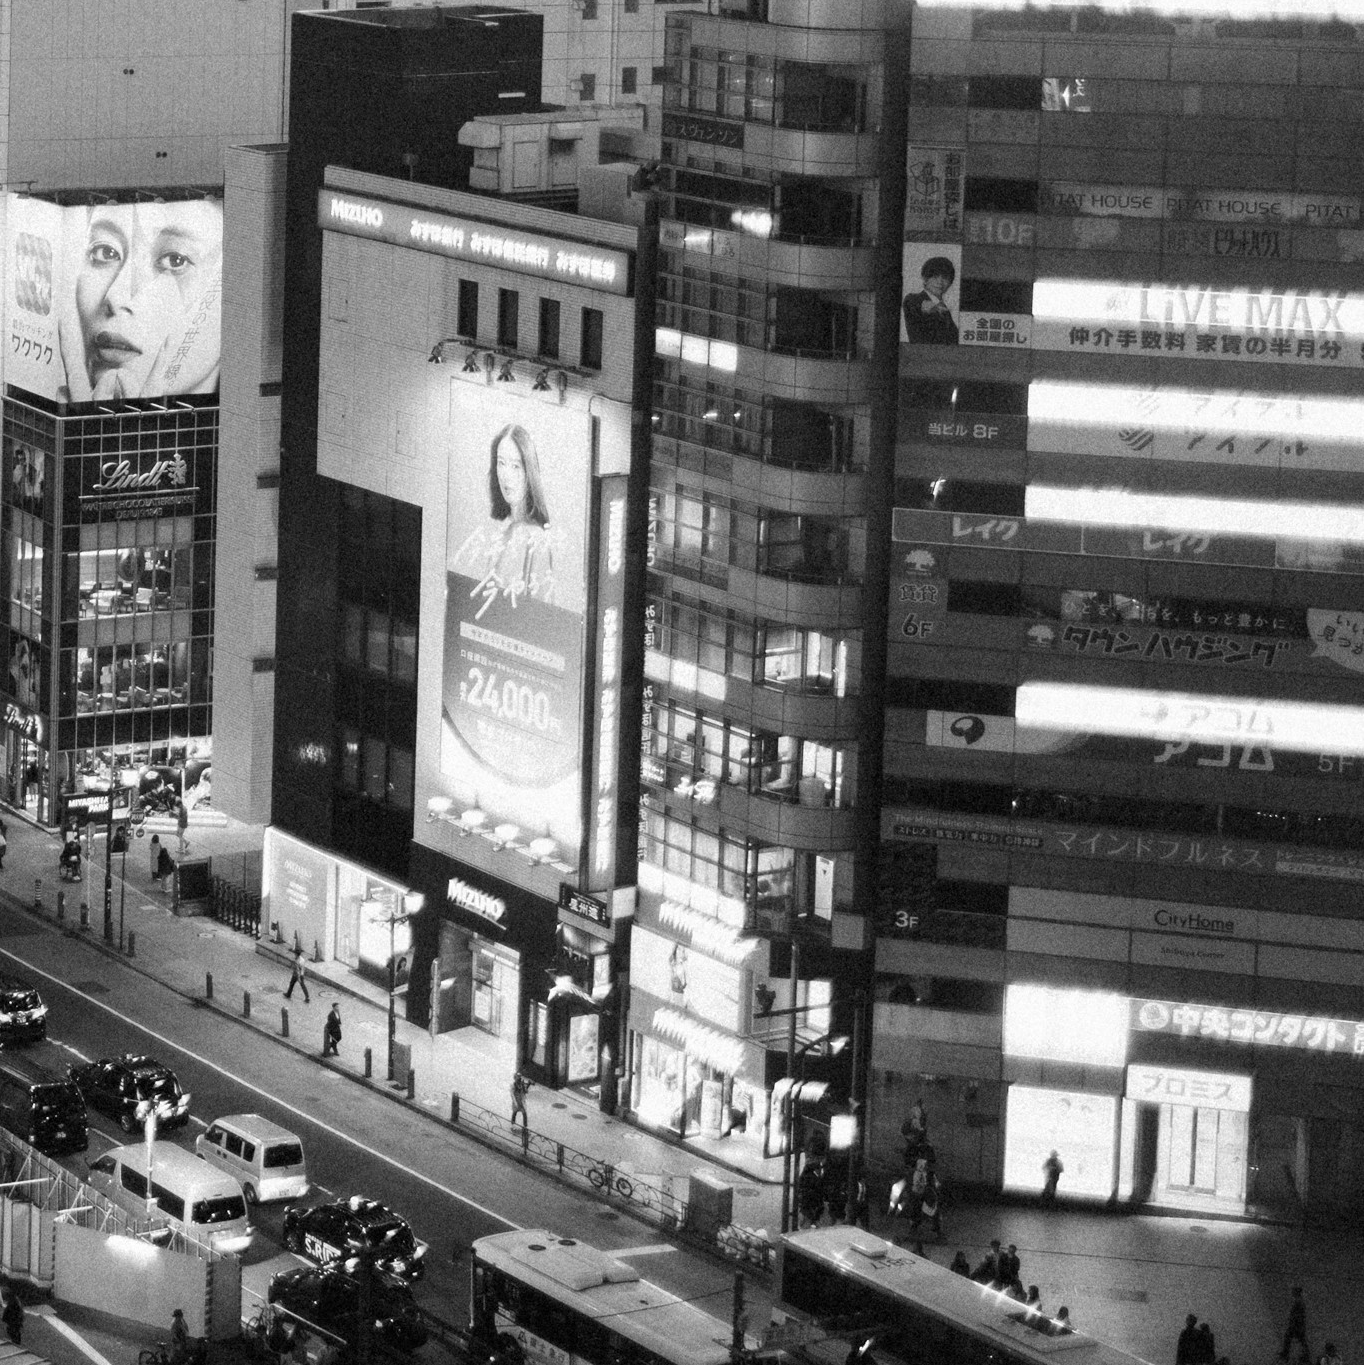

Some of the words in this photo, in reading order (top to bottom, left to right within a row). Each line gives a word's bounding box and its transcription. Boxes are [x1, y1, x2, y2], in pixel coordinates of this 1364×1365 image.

[331, 198, 383, 227] MIZUHO
[1091, 194, 1153, 210] HOUSE
[1218, 200, 1281, 215] HOUSE
[1305, 203, 1354, 218] PITAT
[977, 318, 1016, 331] 全国の
[1247, 290, 1345, 335] MAX
[12, 334, 54, 365] ワクワク
[1070, 326, 1186, 352] 仲介手数料
[1197, 330, 1342, 361] 家賃の半月分
[929, 423, 967, 437] 当ビル
[972, 424, 999, 439] 8F
[93, 460, 169, 490] Lindt
[952, 516, 1019, 539] レイク
[902, 614, 934, 639] 6F
[1063, 624, 1290, 667] タウンハウジング
[1318, 752, 1355, 774] 5F
[1056, 830, 1264, 869] マインドフルネス
[448, 878, 505, 922] MIZUHO
[895, 910, 919, 929] 3F
[1154, 908, 1235, 932] CityHome
[1173, 1005, 1346, 1051] 中央コンタクト
[1142, 1073, 1234, 1102] プロミス
